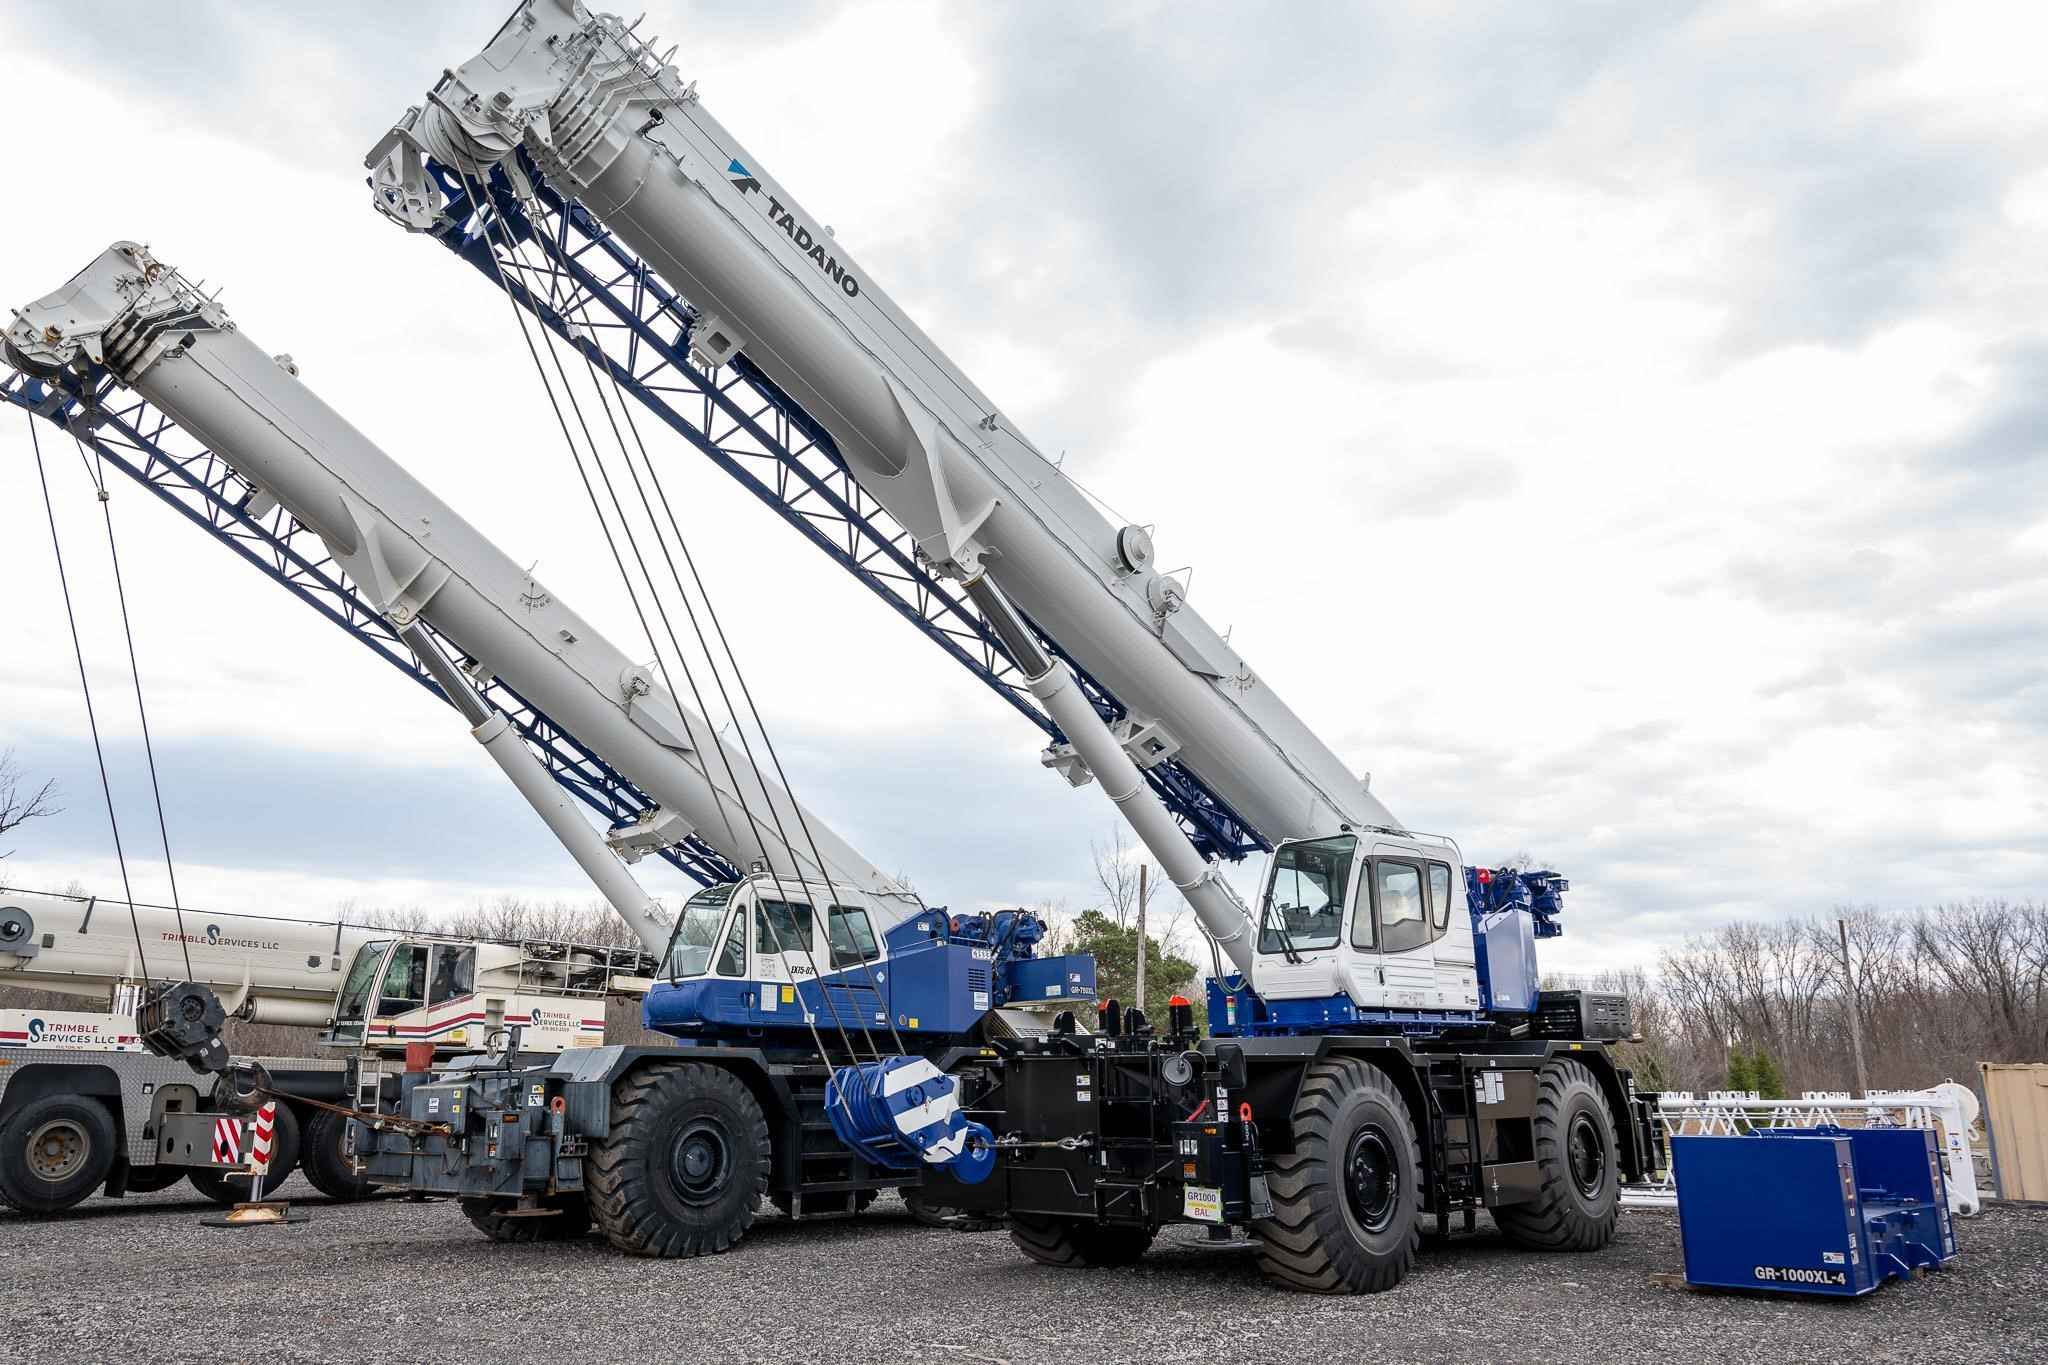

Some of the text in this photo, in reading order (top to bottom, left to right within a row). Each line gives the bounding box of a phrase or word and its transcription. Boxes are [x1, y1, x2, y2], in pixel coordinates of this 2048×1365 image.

[768, 195, 859, 297] TADANO
[162, 924, 279, 950] TRIMBLE SERVICES LLC
[542, 1011, 571, 1019] TRIMBLE
[48, 1023, 99, 1033] TRIMBLE
[568, 1020, 581, 1028] LLC
[28, 1018, 88, 1044] SERVICES
[95, 1035, 115, 1044] LLC
[1187, 1191, 1217, 1203] GR1000
[1194, 1207, 1210, 1217] BAL
[1754, 1266, 1847, 1286] GR-1000XL-4
